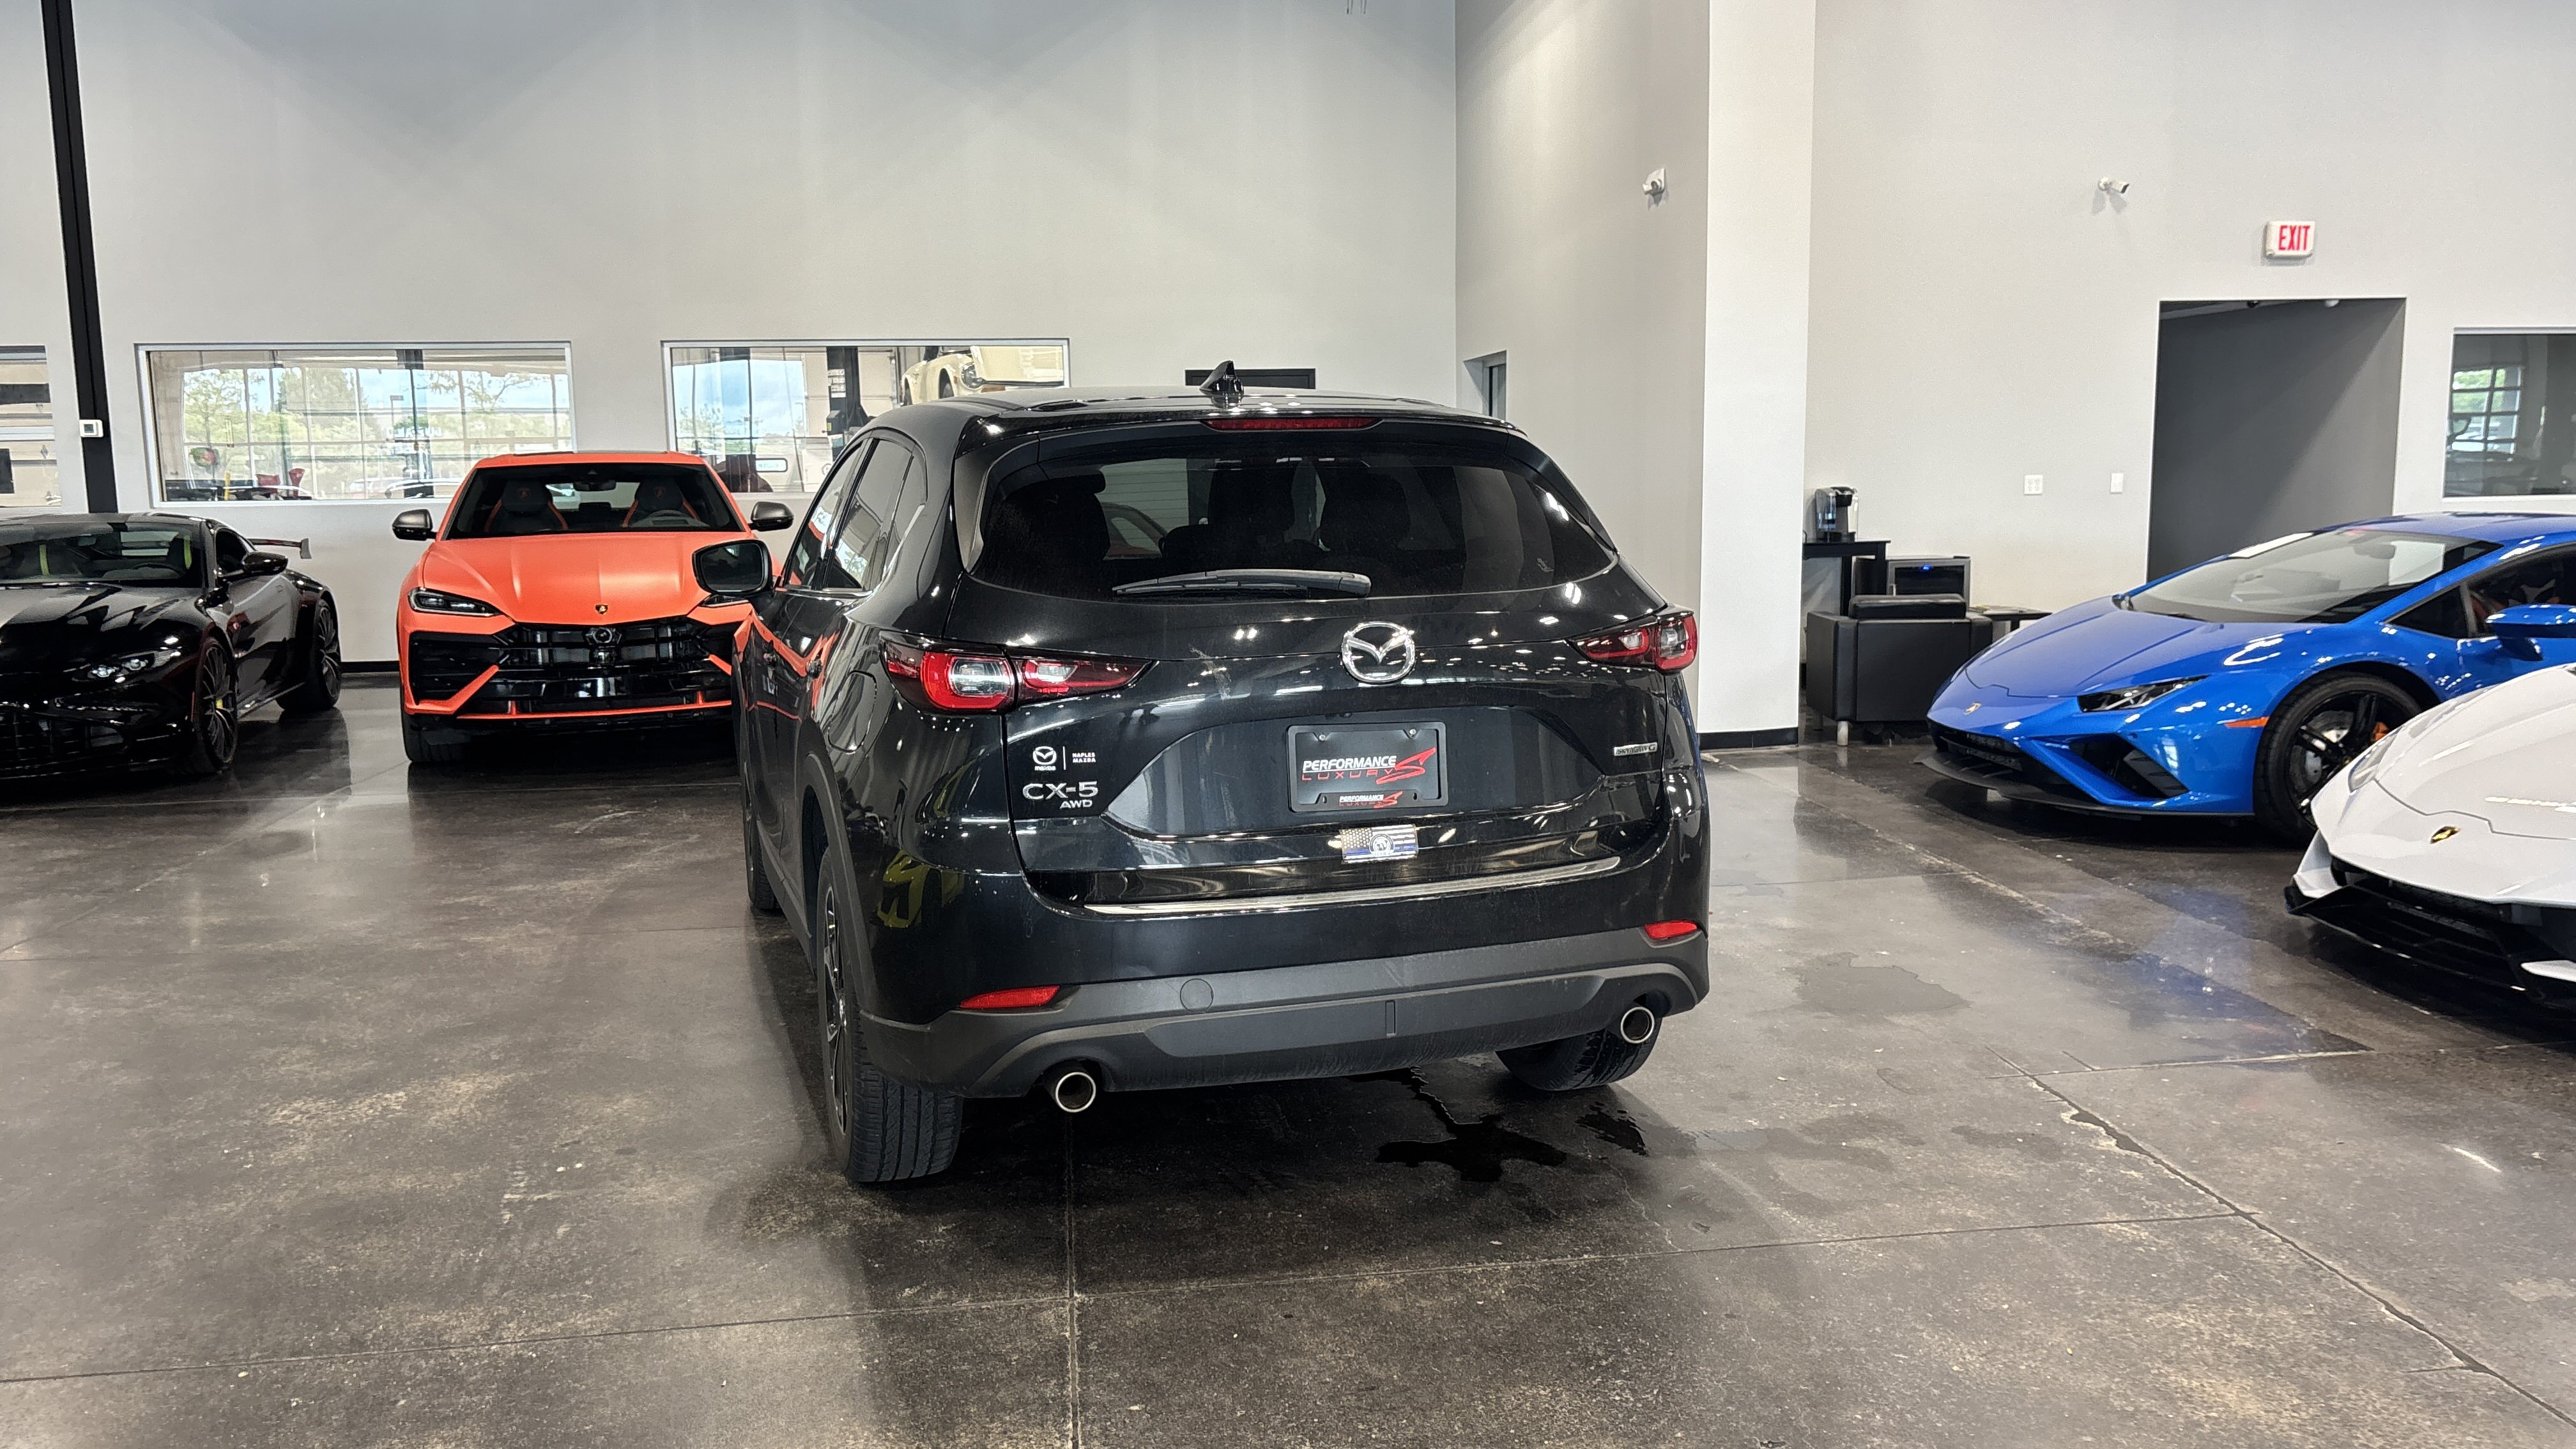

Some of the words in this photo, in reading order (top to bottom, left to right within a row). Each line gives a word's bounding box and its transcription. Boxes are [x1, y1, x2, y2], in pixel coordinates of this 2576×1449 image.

[2278, 225, 2310, 250] EXIT
[1302, 755, 1397, 771] PERFORMANCE
[1022, 781, 1098, 800] CX-5
[1339, 794, 1384, 802] PERFORMANCE
[1059, 799, 1092, 809] AWD
